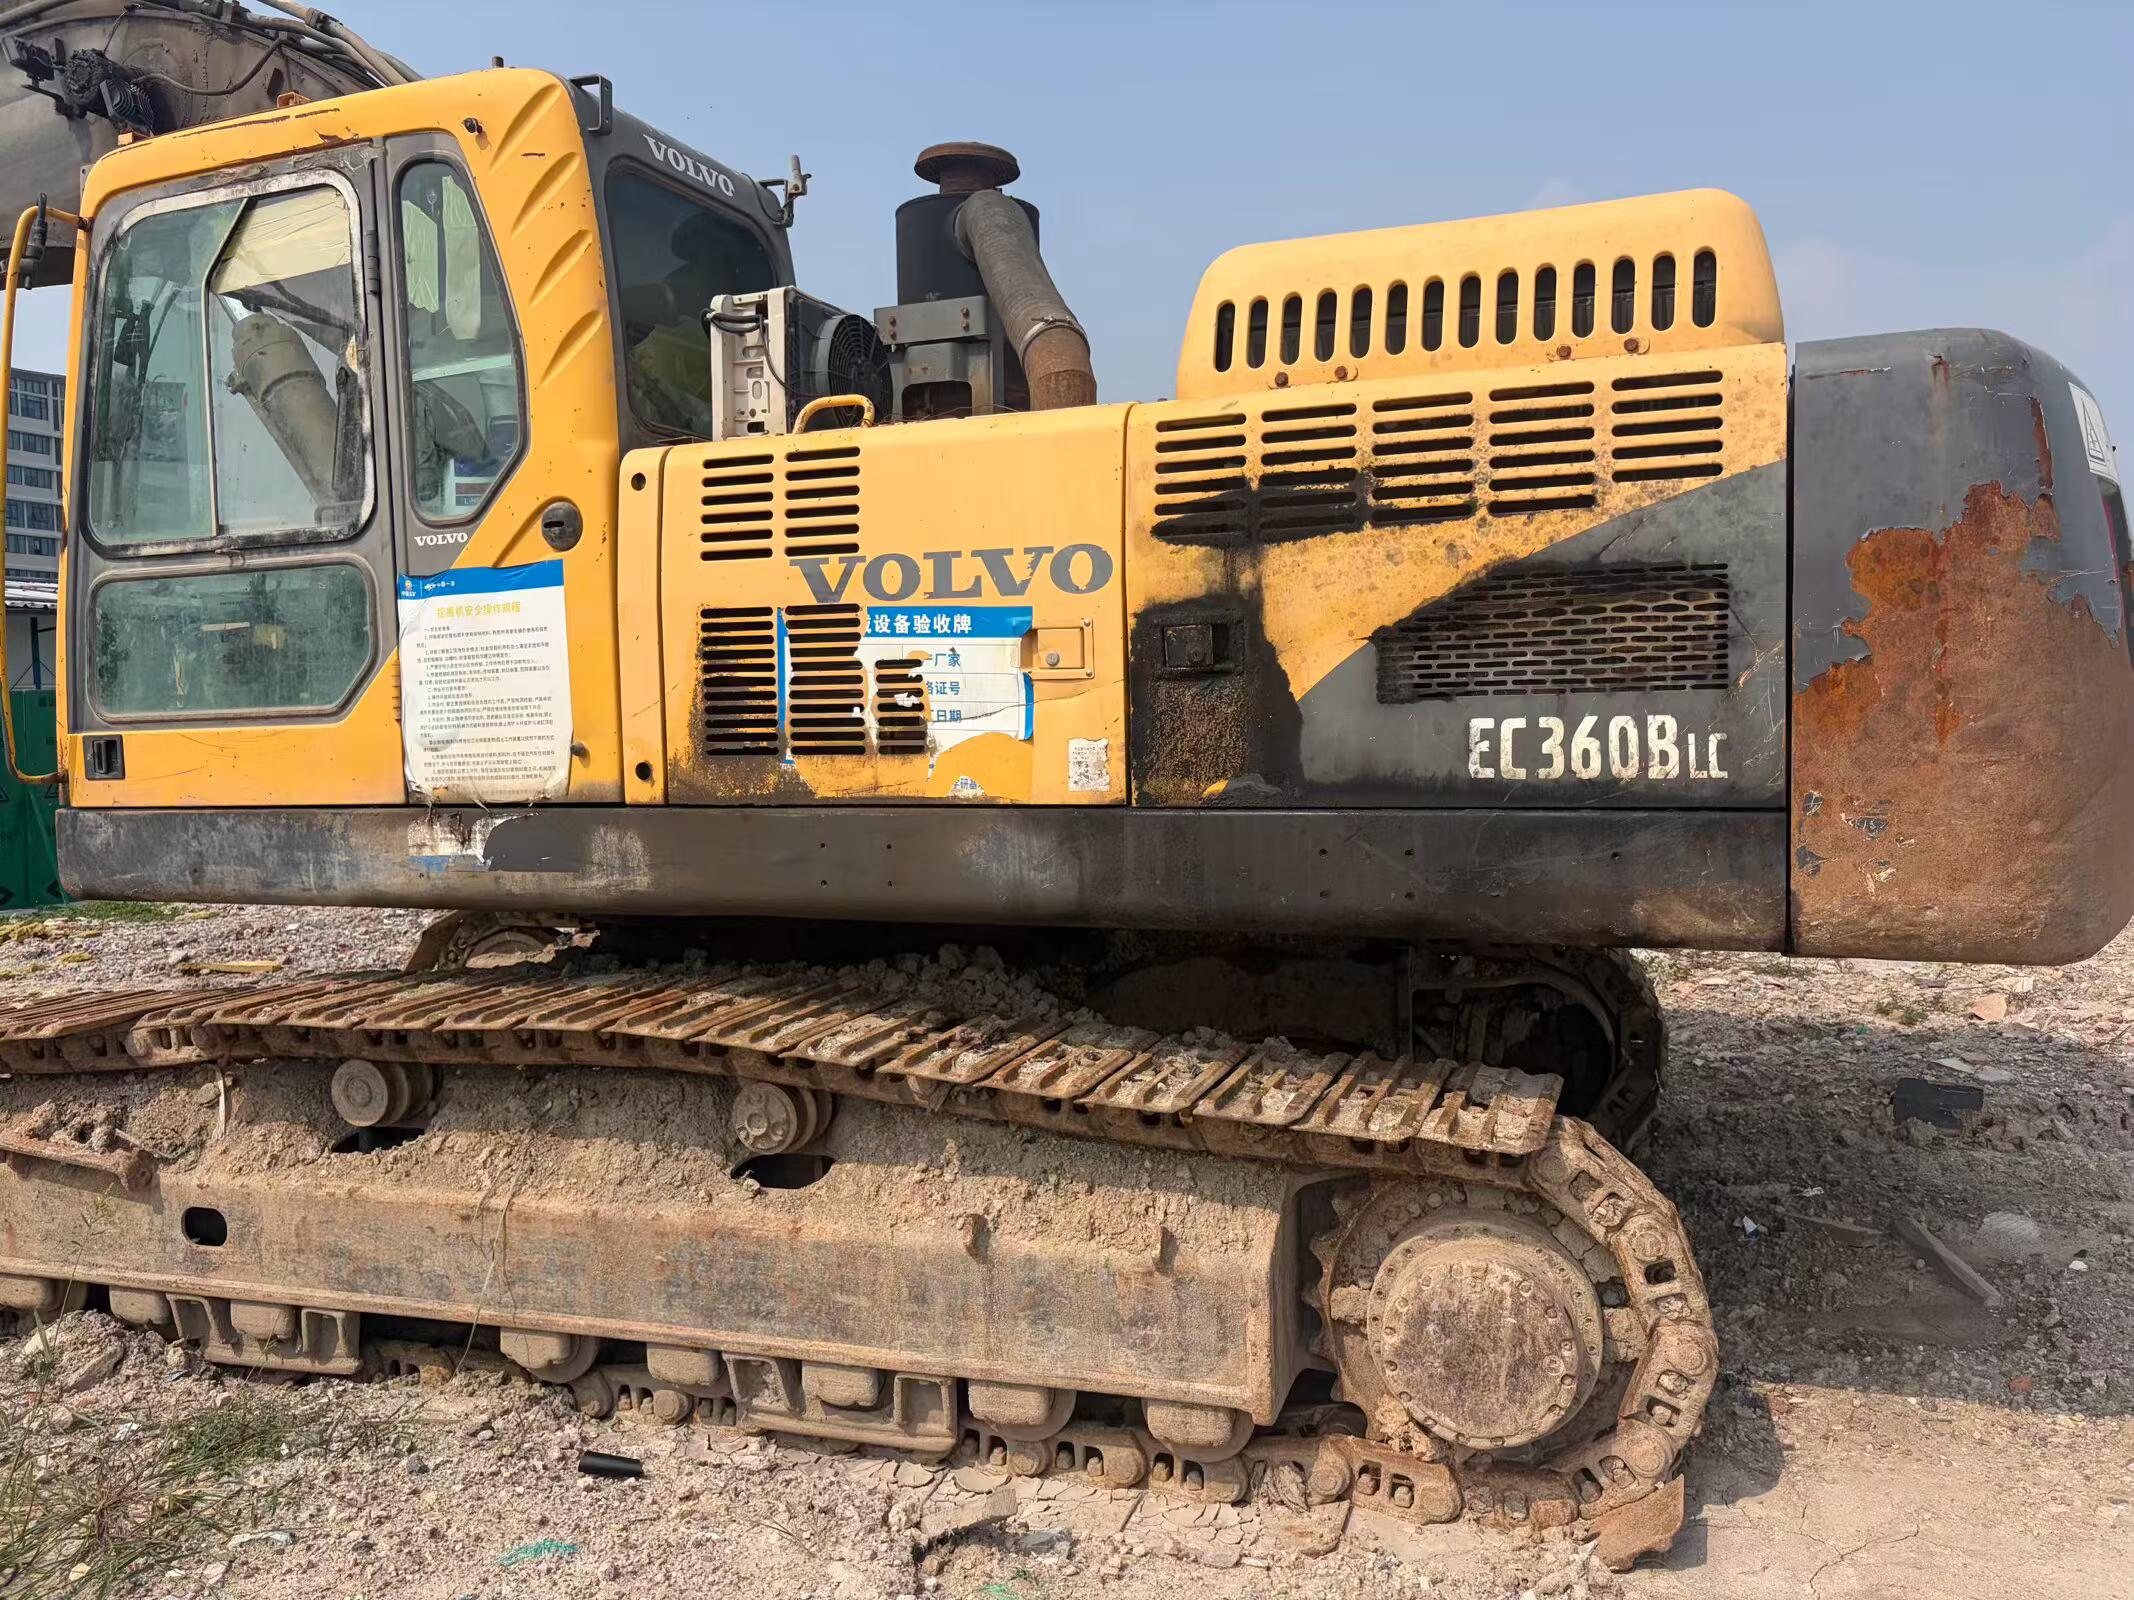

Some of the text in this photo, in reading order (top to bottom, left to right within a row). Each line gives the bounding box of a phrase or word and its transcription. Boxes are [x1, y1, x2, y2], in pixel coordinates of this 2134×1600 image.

[643, 134, 735, 197] VOLVO
[414, 532, 468, 547] VOLVO
[789, 543, 1114, 604] VOLVO
[930, 709, 962, 723] 日期
